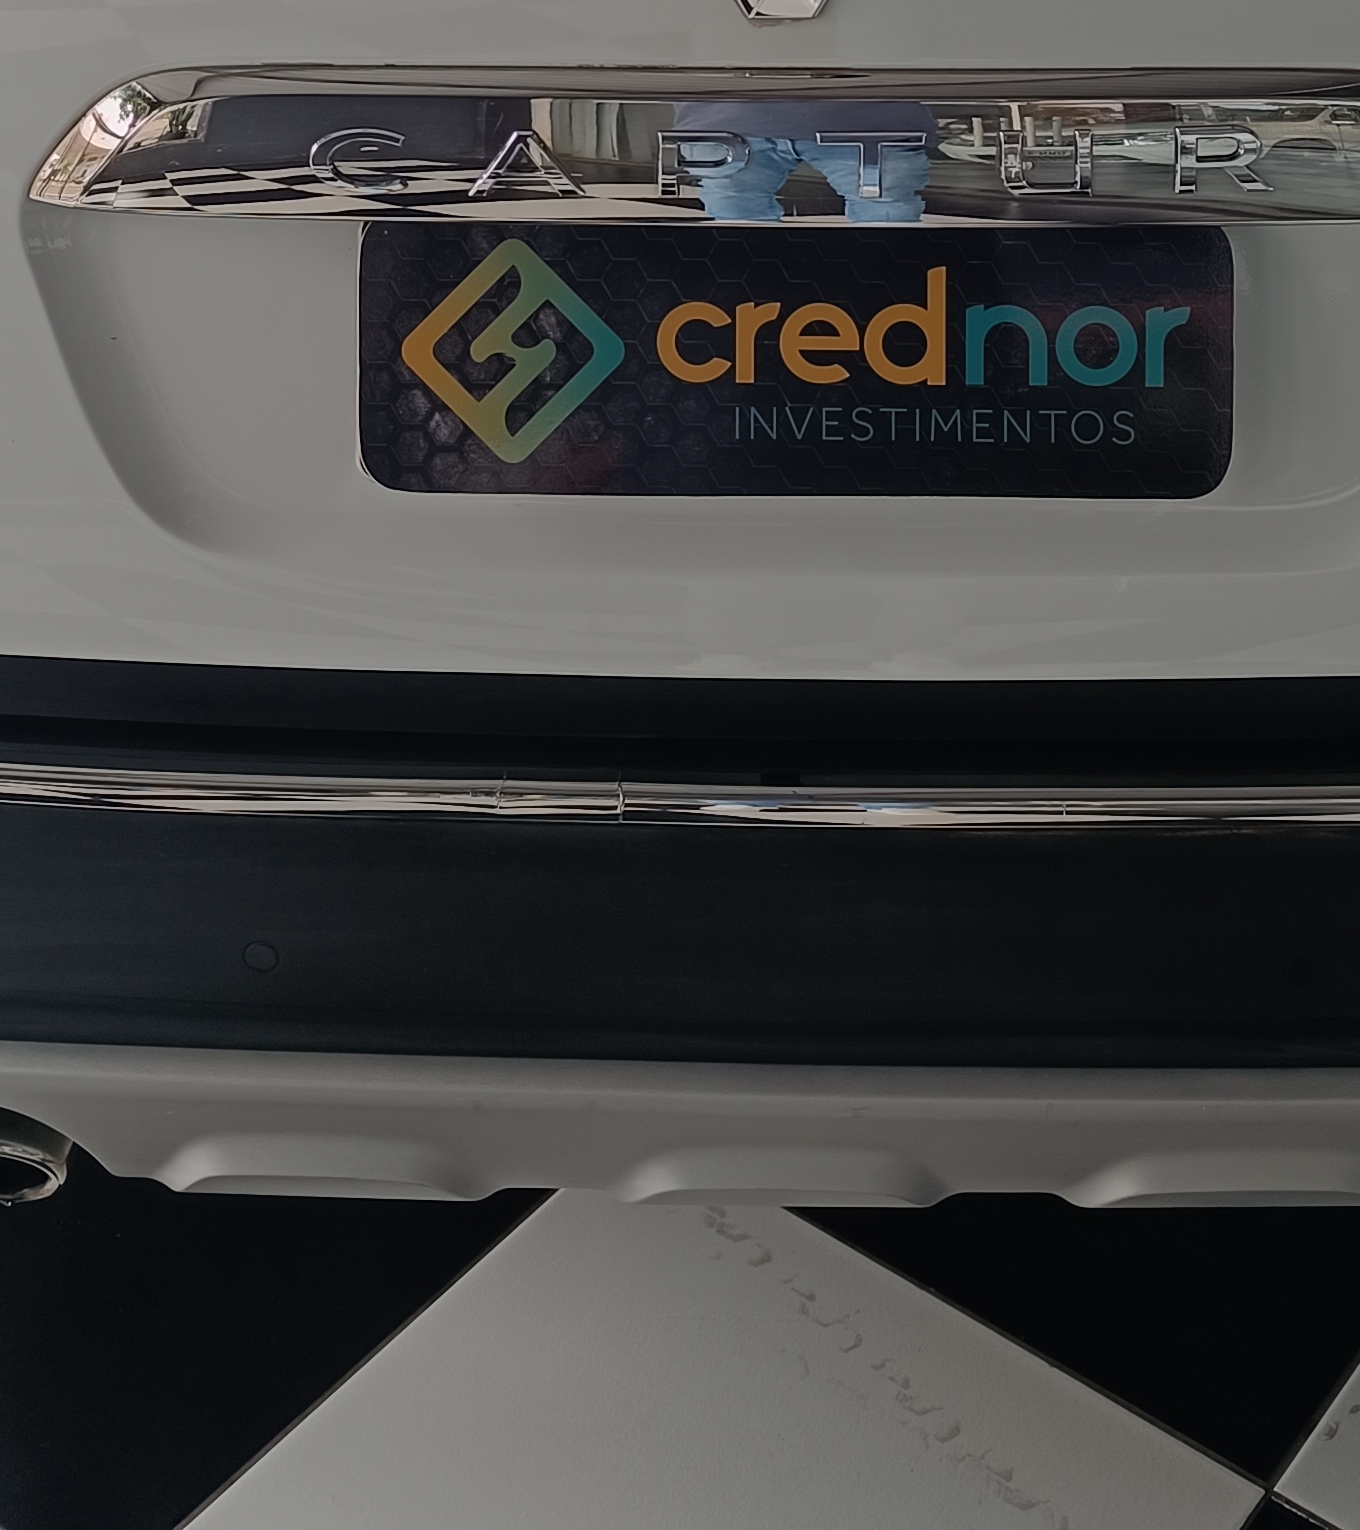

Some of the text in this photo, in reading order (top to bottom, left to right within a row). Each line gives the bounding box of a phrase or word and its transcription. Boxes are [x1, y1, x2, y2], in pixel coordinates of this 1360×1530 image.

[308, 127, 1276, 198] CAPTUR
[656, 266, 1191, 387] crednor
[734, 406, 1136, 446] INVESTIMENTOS
